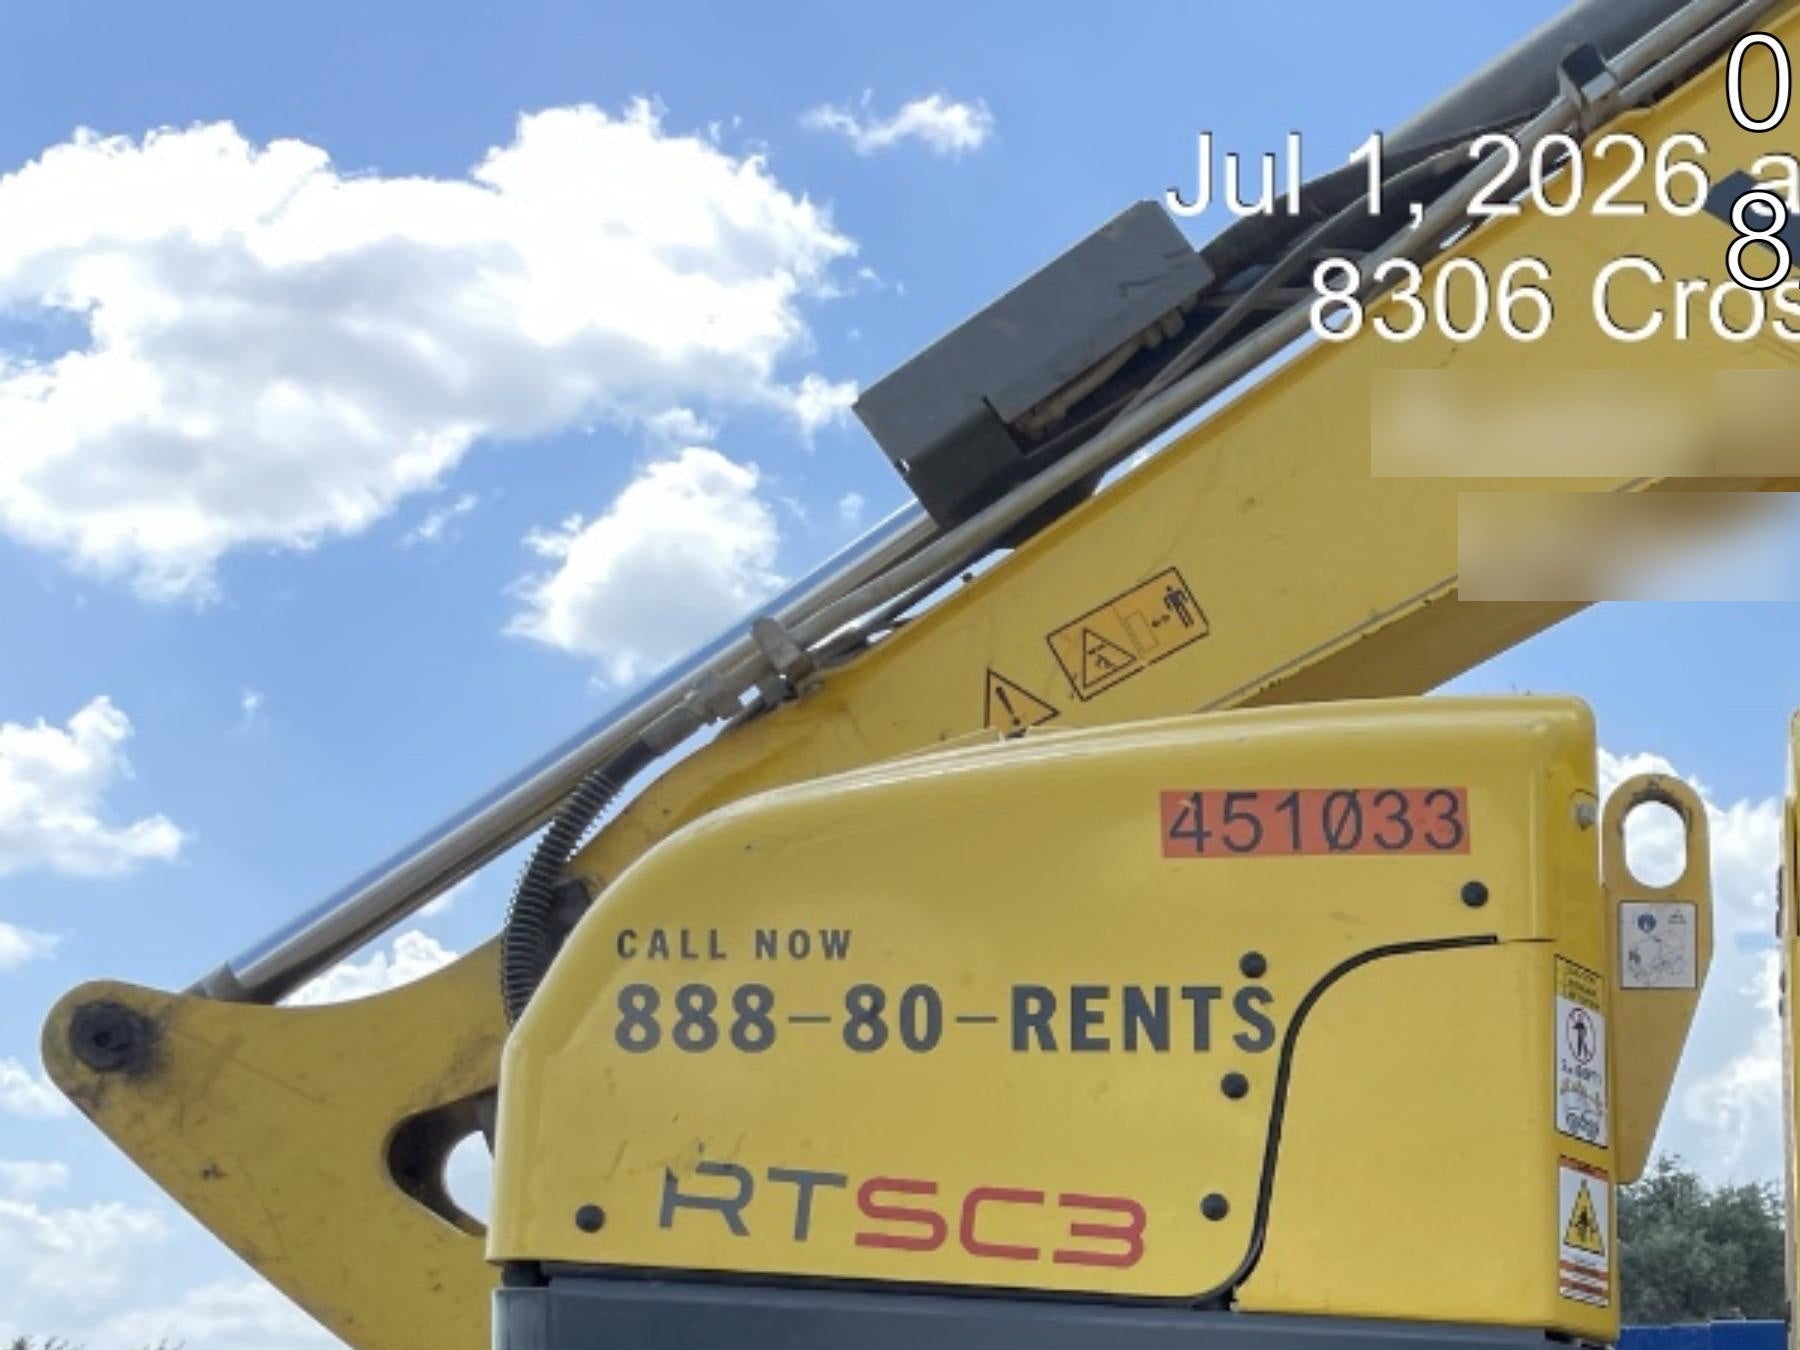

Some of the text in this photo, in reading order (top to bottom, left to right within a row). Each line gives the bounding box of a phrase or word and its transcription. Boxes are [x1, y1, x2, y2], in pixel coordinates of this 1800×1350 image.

[1170, 789, 1464, 853] 451033
[616, 929, 853, 960] CALL NOW
[614, 983, 1276, 1054] 888-80-RENTS
[659, 1161, 1147, 1269] RTSC3
